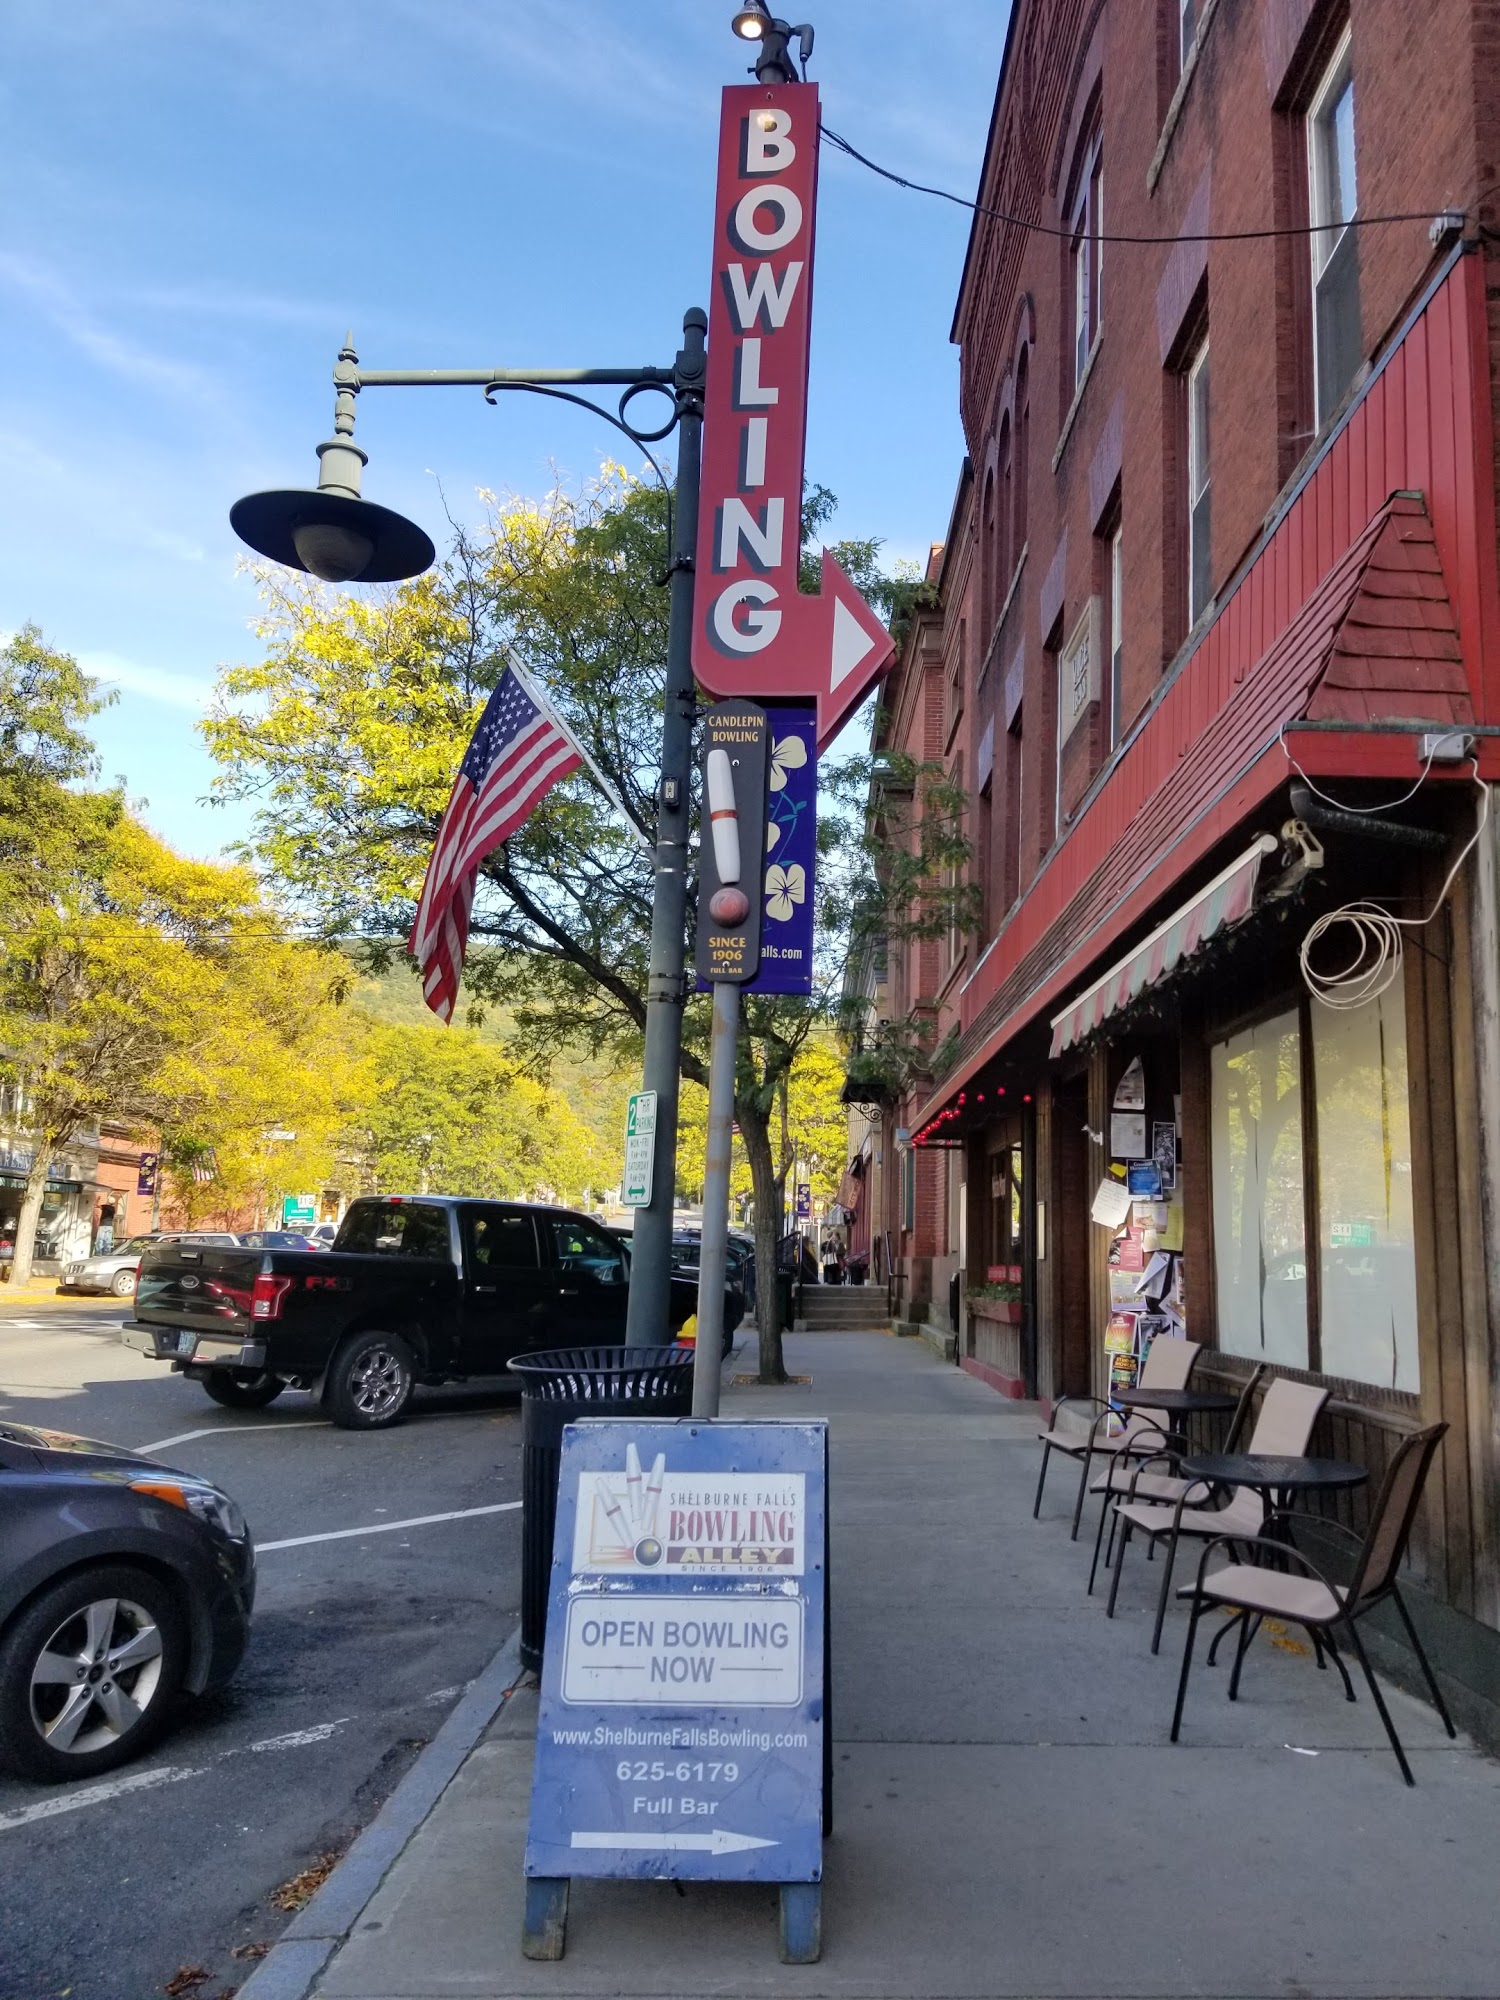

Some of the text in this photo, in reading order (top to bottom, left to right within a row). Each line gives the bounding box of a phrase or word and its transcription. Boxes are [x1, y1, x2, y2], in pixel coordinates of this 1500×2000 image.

[713, 108, 803, 654] BOWLING
[708, 715, 764, 727] CANDLEPIN
[712, 731, 759, 742] BOWLING
[708, 937, 747, 948] SINCE
[712, 950, 743, 960] 1906
[761, 945, 803, 960] alls.com
[629, 1103, 636, 1130] 2
[670, 1492, 797, 1506] SHELBURNE FALLS
[669, 1510, 795, 1542] BOWLING
[679, 1548, 785, 1564] ALLEY
[581, 1620, 789, 1649] OPEN BOWLING
[650, 1656, 715, 1683] NOW
[553, 1727, 808, 1751] www.ShelburneFallsBowling.com
[616, 1761, 739, 1782] 625-6179
[633, 1797, 719, 1815] Full Bar
